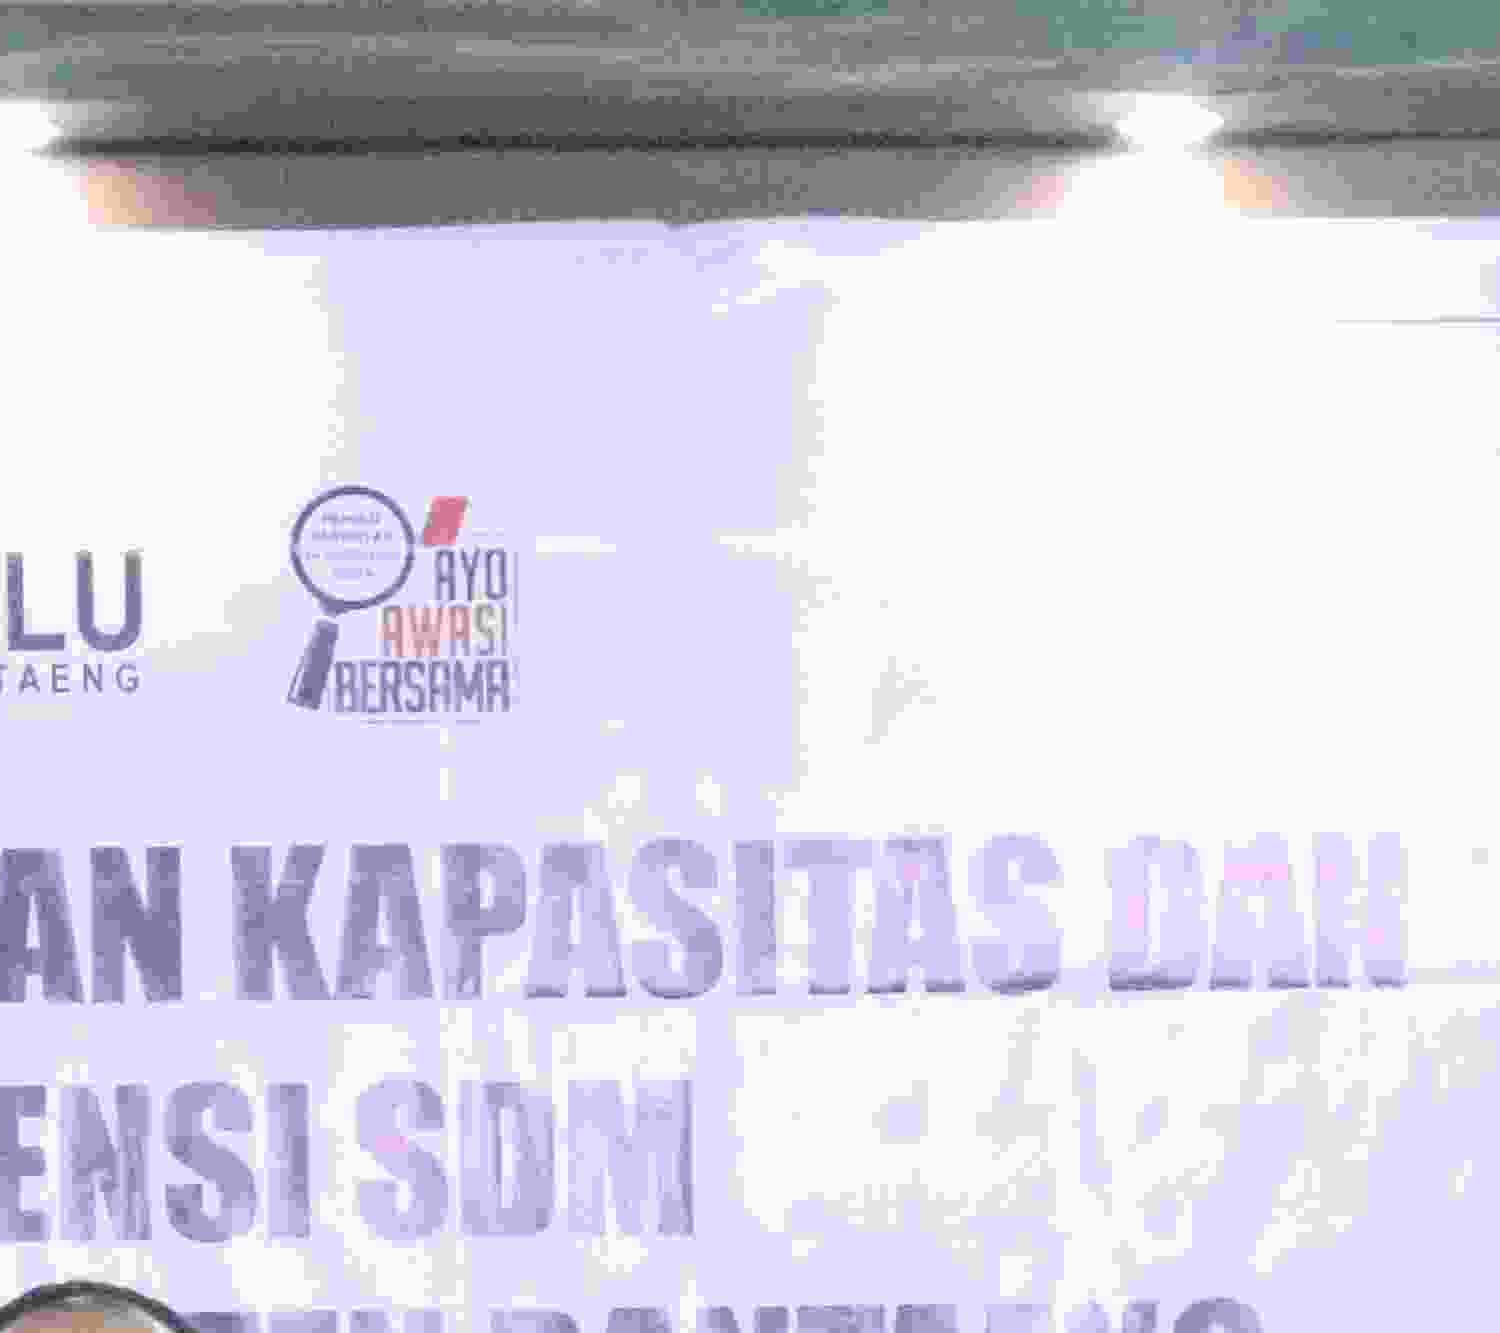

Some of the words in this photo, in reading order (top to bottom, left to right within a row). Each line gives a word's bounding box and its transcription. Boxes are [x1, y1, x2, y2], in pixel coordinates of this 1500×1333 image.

[434, 547, 508, 600] AYO
[380, 602, 508, 656] AWASI
[334, 659, 512, 712] BERSAMA
[228, 833, 1064, 1000] KAPASITAS
[1106, 832, 1408, 992] DAN
[355, 1079, 696, 1240] SDM
